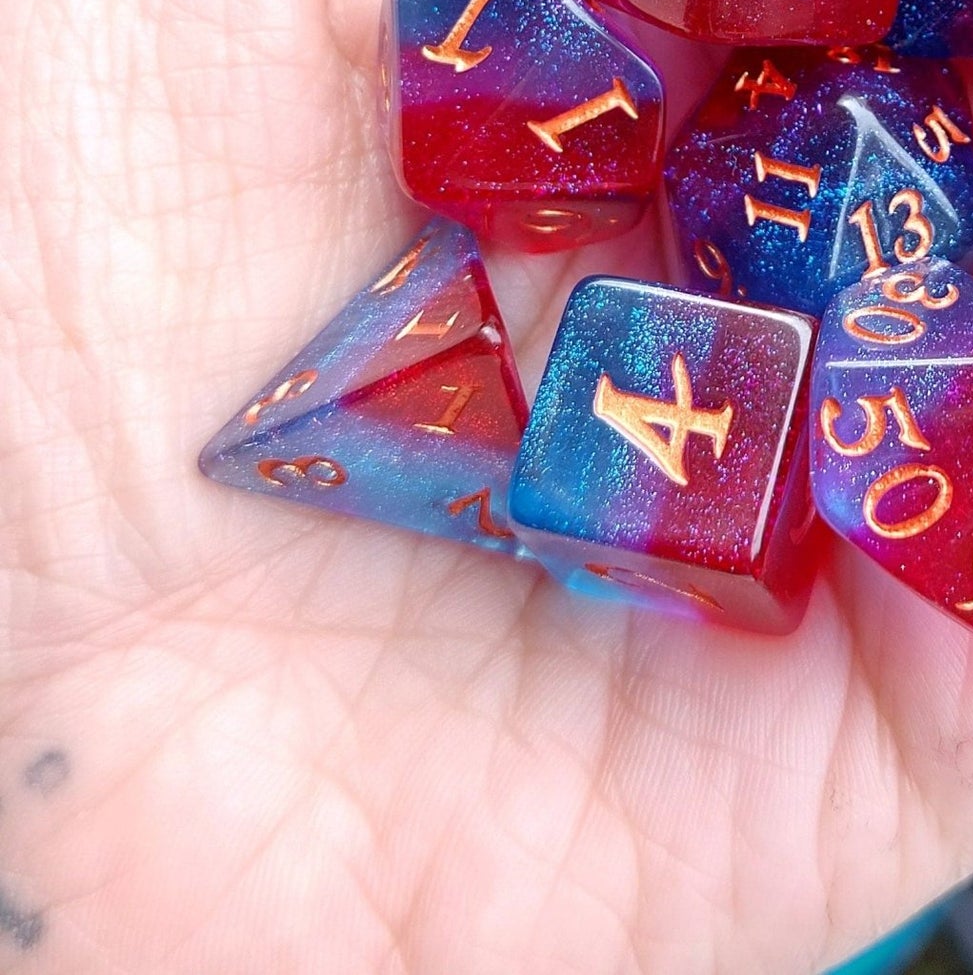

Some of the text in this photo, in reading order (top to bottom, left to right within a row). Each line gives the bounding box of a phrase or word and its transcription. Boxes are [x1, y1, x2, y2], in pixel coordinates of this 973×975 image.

[744, 151, 822, 243] 11
[848, 188, 934, 280] 13
[593, 351, 734, 486] 4
